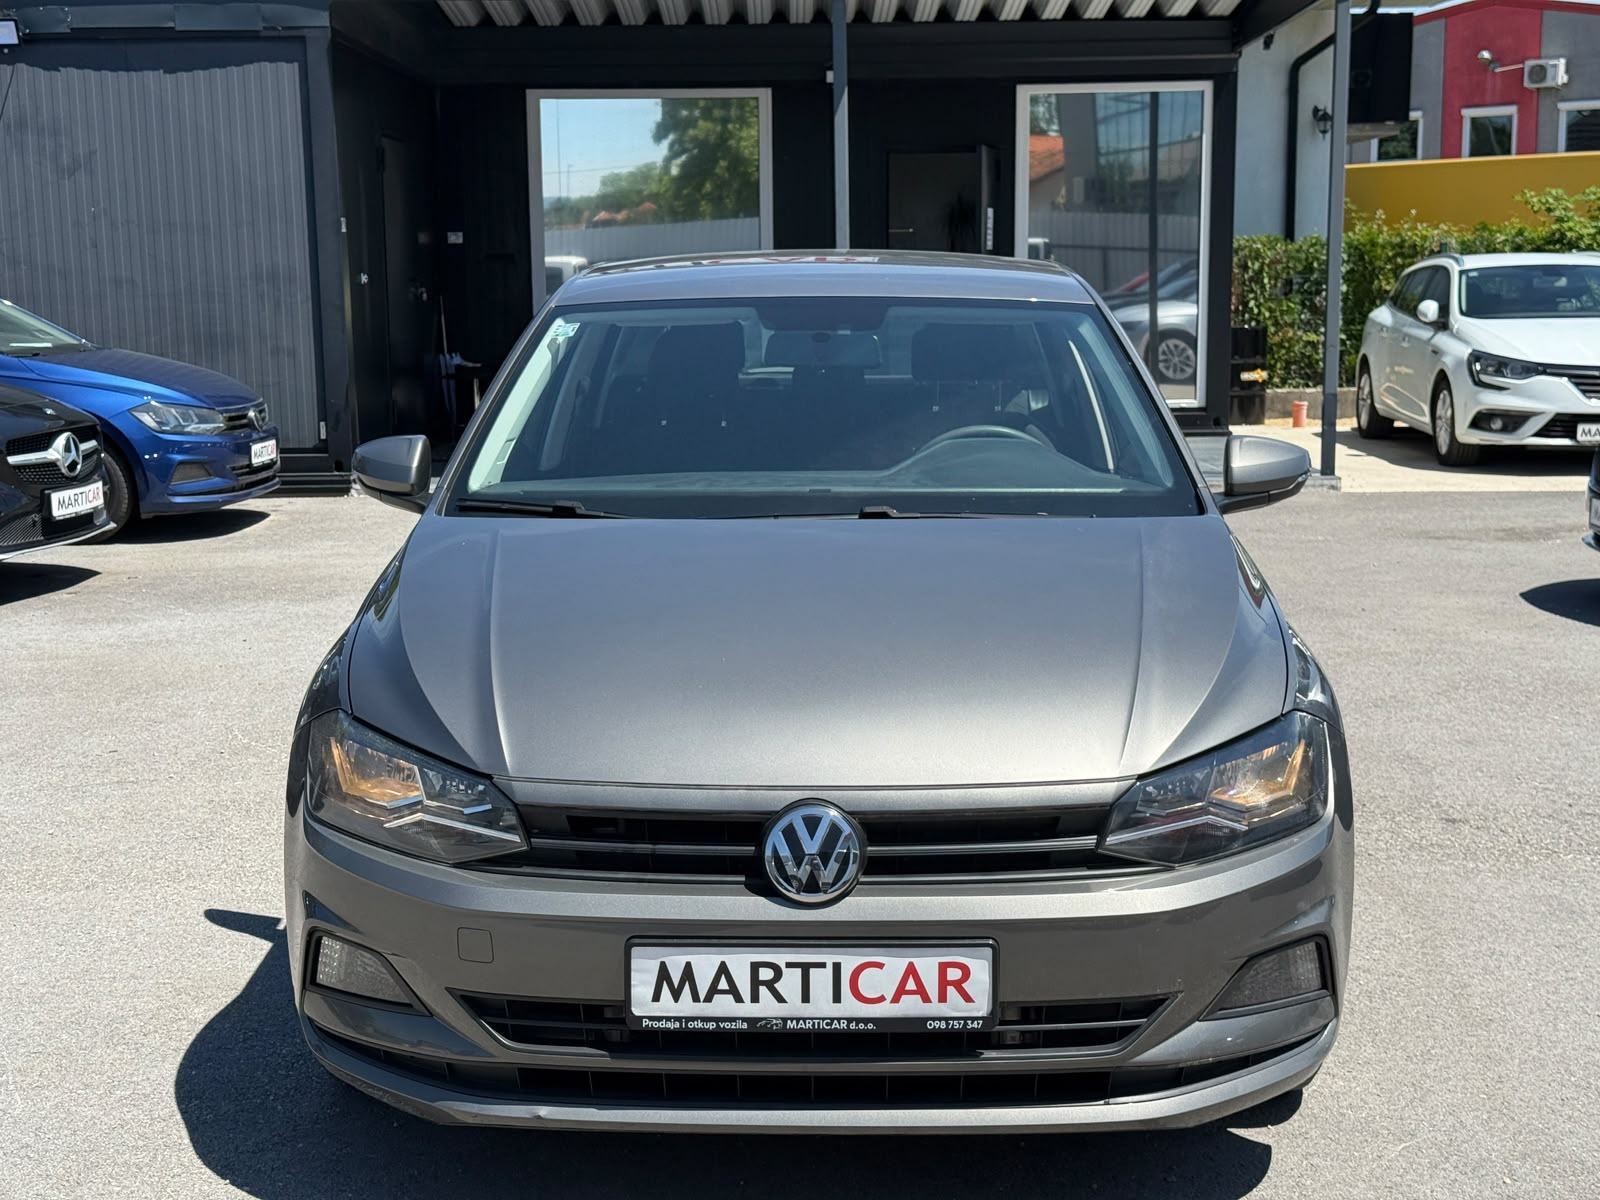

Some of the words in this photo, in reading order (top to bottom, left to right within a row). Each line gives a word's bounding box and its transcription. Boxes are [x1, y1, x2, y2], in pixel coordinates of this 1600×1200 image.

[57, 486, 101, 511] MARTICAR
[650, 960, 976, 1005] MARTICAR
[642, 1018, 680, 1031] Prodaja
[682, 1018, 686, 1029] i
[687, 1019, 717, 1031] otkup
[718, 1019, 748, 1030] vozila
[786, 1019, 848, 1030] MARTICAR
[849, 1020, 877, 1030] d.o.o.
[926, 1020, 947, 1030] 098
[947, 1020, 965, 1029] 757
[966, 1019, 984, 1030] 347
